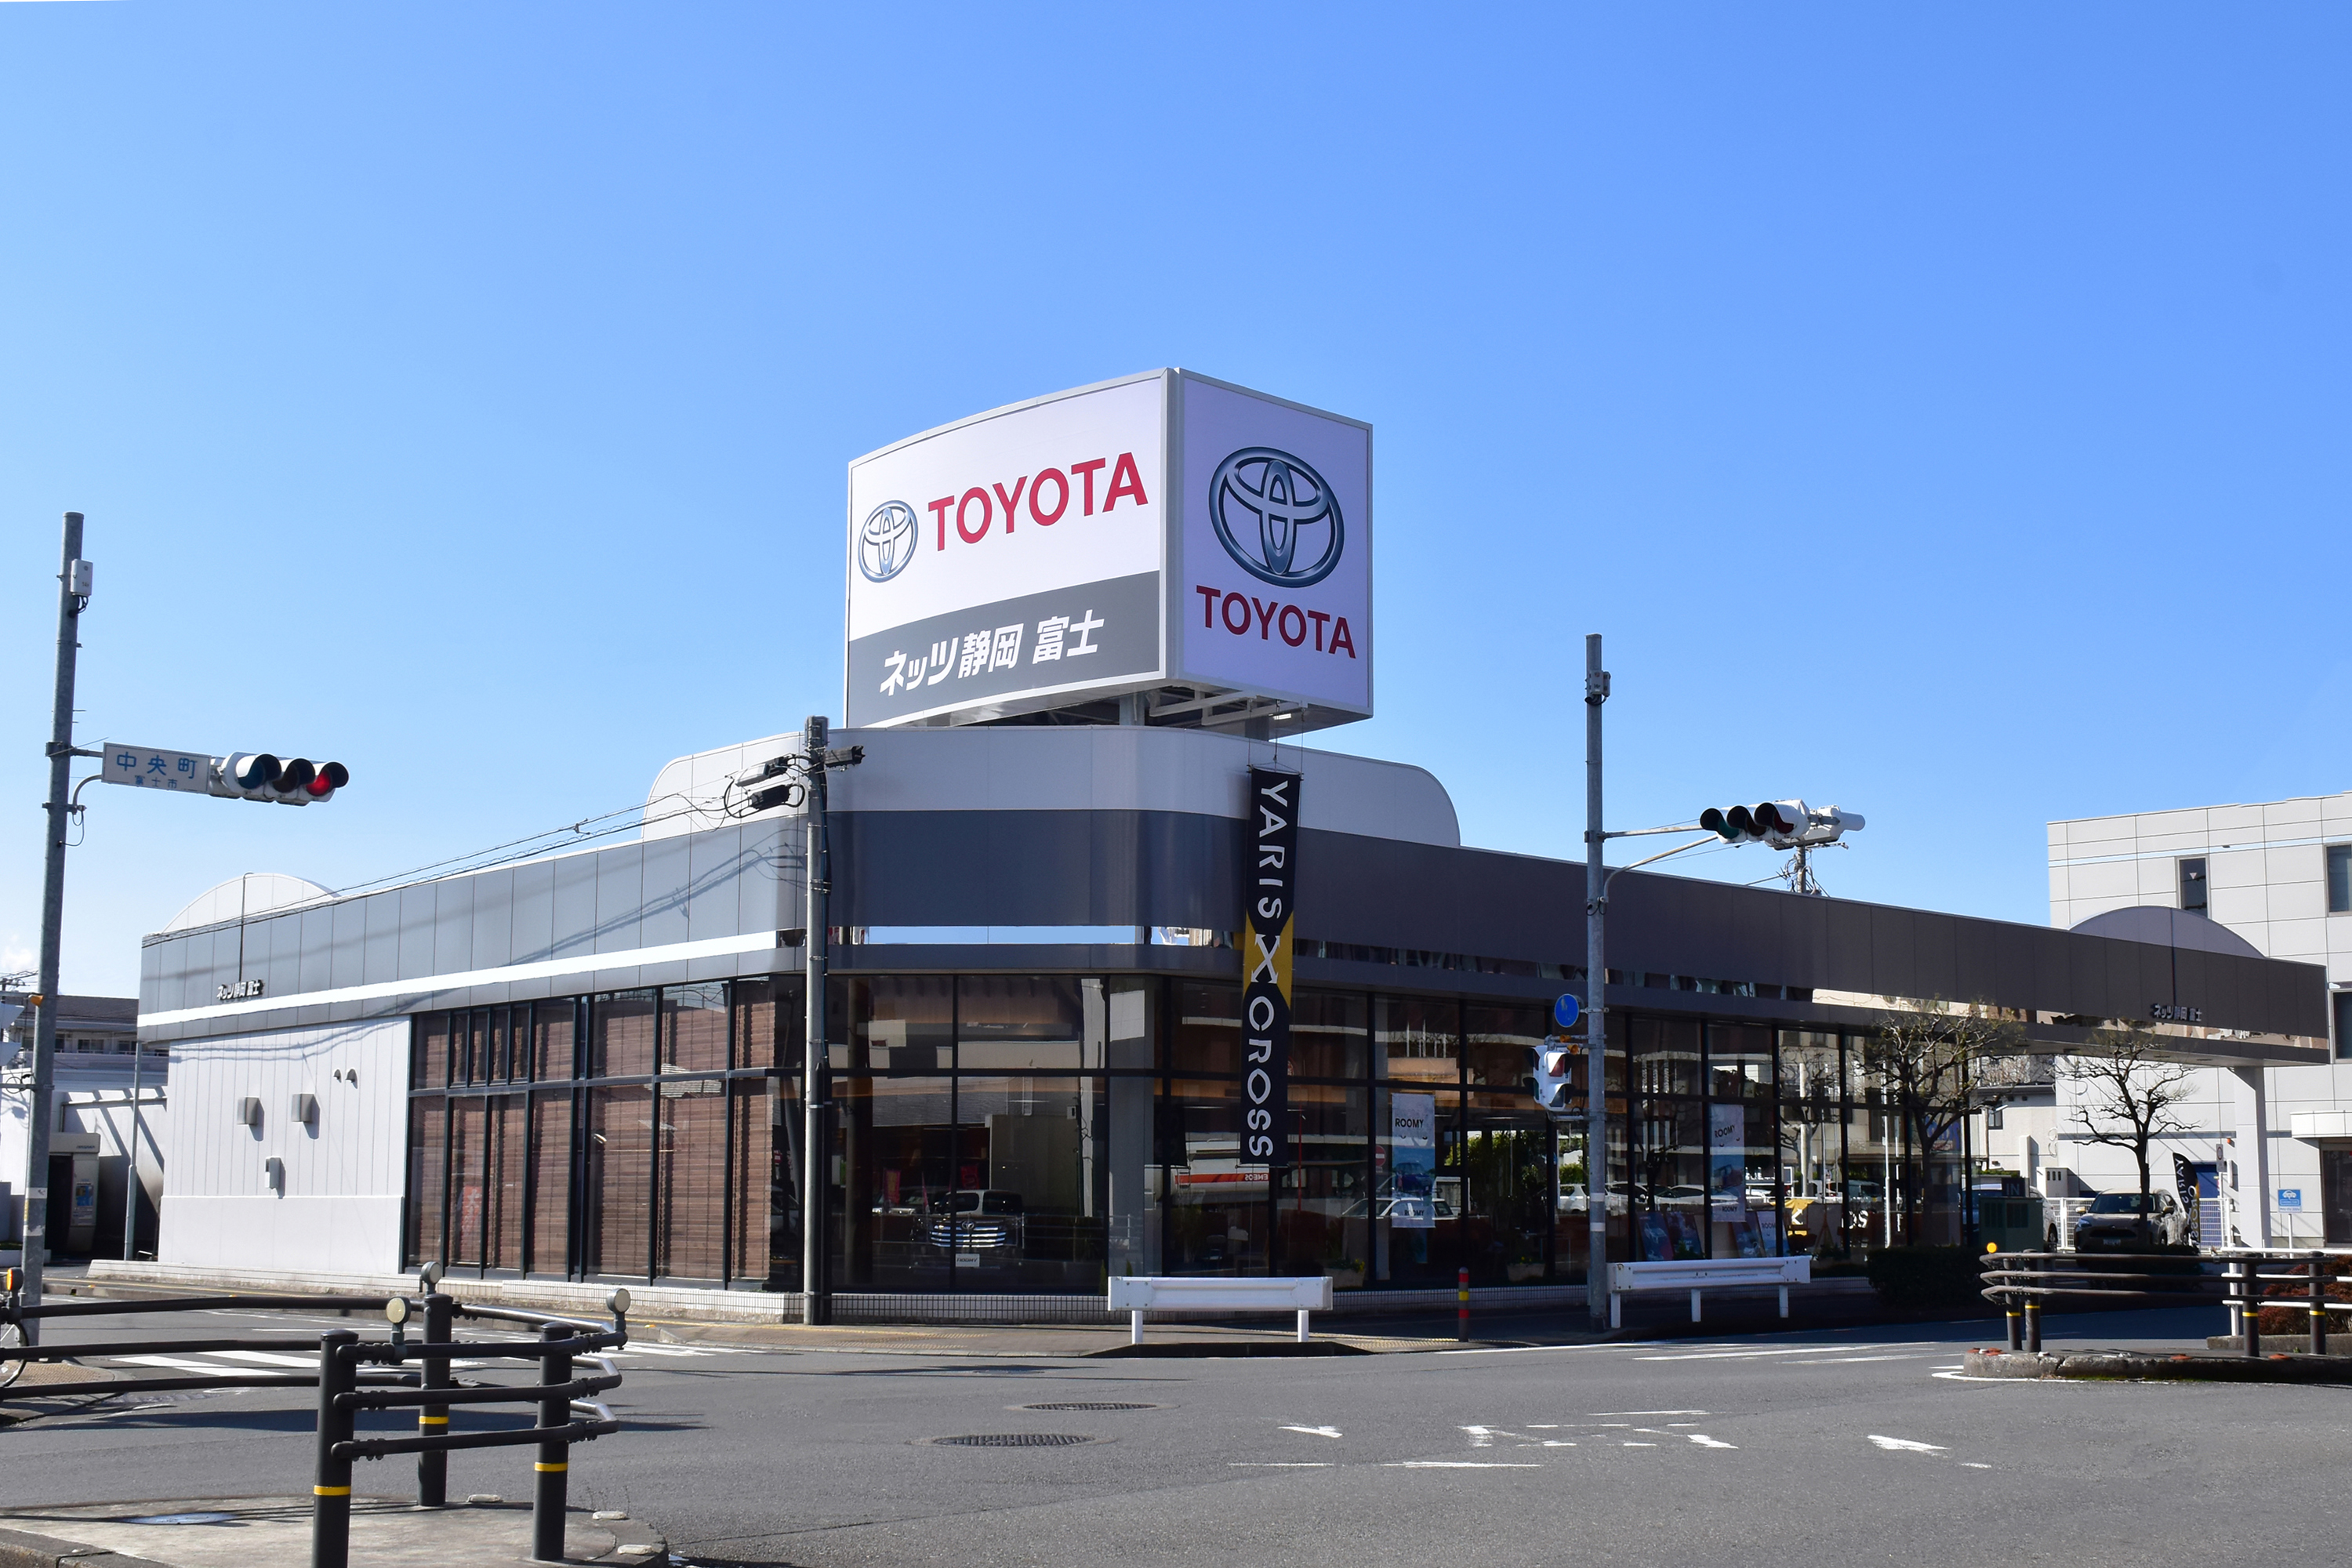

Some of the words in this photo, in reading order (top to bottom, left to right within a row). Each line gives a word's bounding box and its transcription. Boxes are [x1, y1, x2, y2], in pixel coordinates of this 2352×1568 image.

[927, 452, 1149, 552] TOYOTA
[1196, 585, 1356, 659] TOYOTA
[879, 622, 1024, 696] ネッツ静岡
[1032, 609, 1105, 665] 富士
[116, 751, 198, 779] 中央町
[135, 775, 178, 789] 富士市
[1257, 780, 1289, 920] YARIS
[1247, 995, 1275, 1157] CROSS
[1395, 1118, 1424, 1128] ROOMY
[1715, 1124, 1735, 1138] ROOMY
[2005, 1183, 2020, 1196] IN
